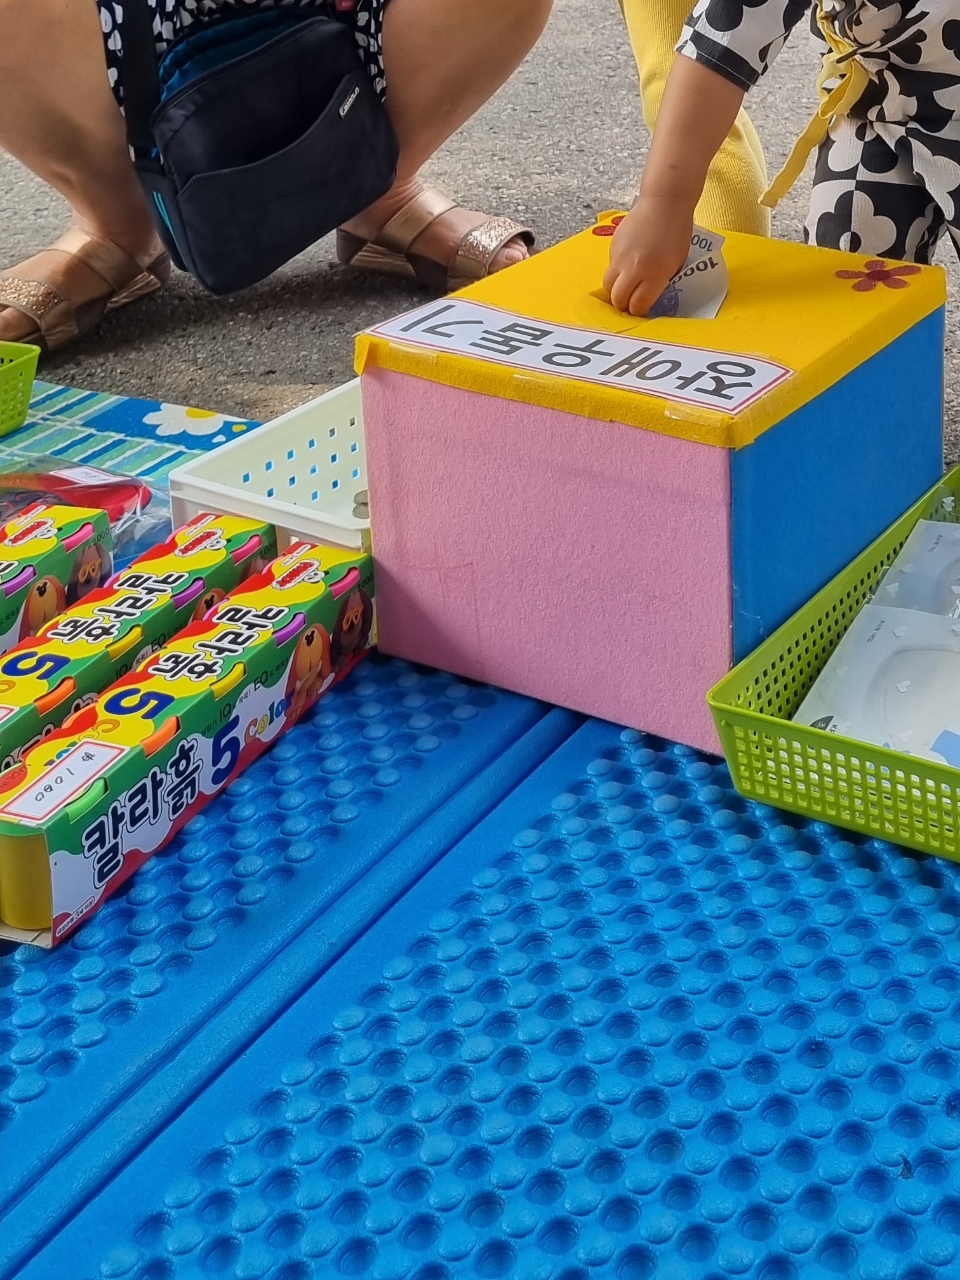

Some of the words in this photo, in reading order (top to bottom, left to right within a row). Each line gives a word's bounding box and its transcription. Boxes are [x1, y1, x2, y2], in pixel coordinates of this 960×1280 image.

[690, 234, 714, 252] 100
[399, 303, 757, 402] 장애우돕기
[49, 572, 187, 643] 칼라흙
[149, 606, 288, 680] 칼라흙
[1, 651, 71, 680] 5
[104, 687, 176, 720] 5
[83, 739, 202, 887] 칼라흙
[211, 714, 240, 785] 5
